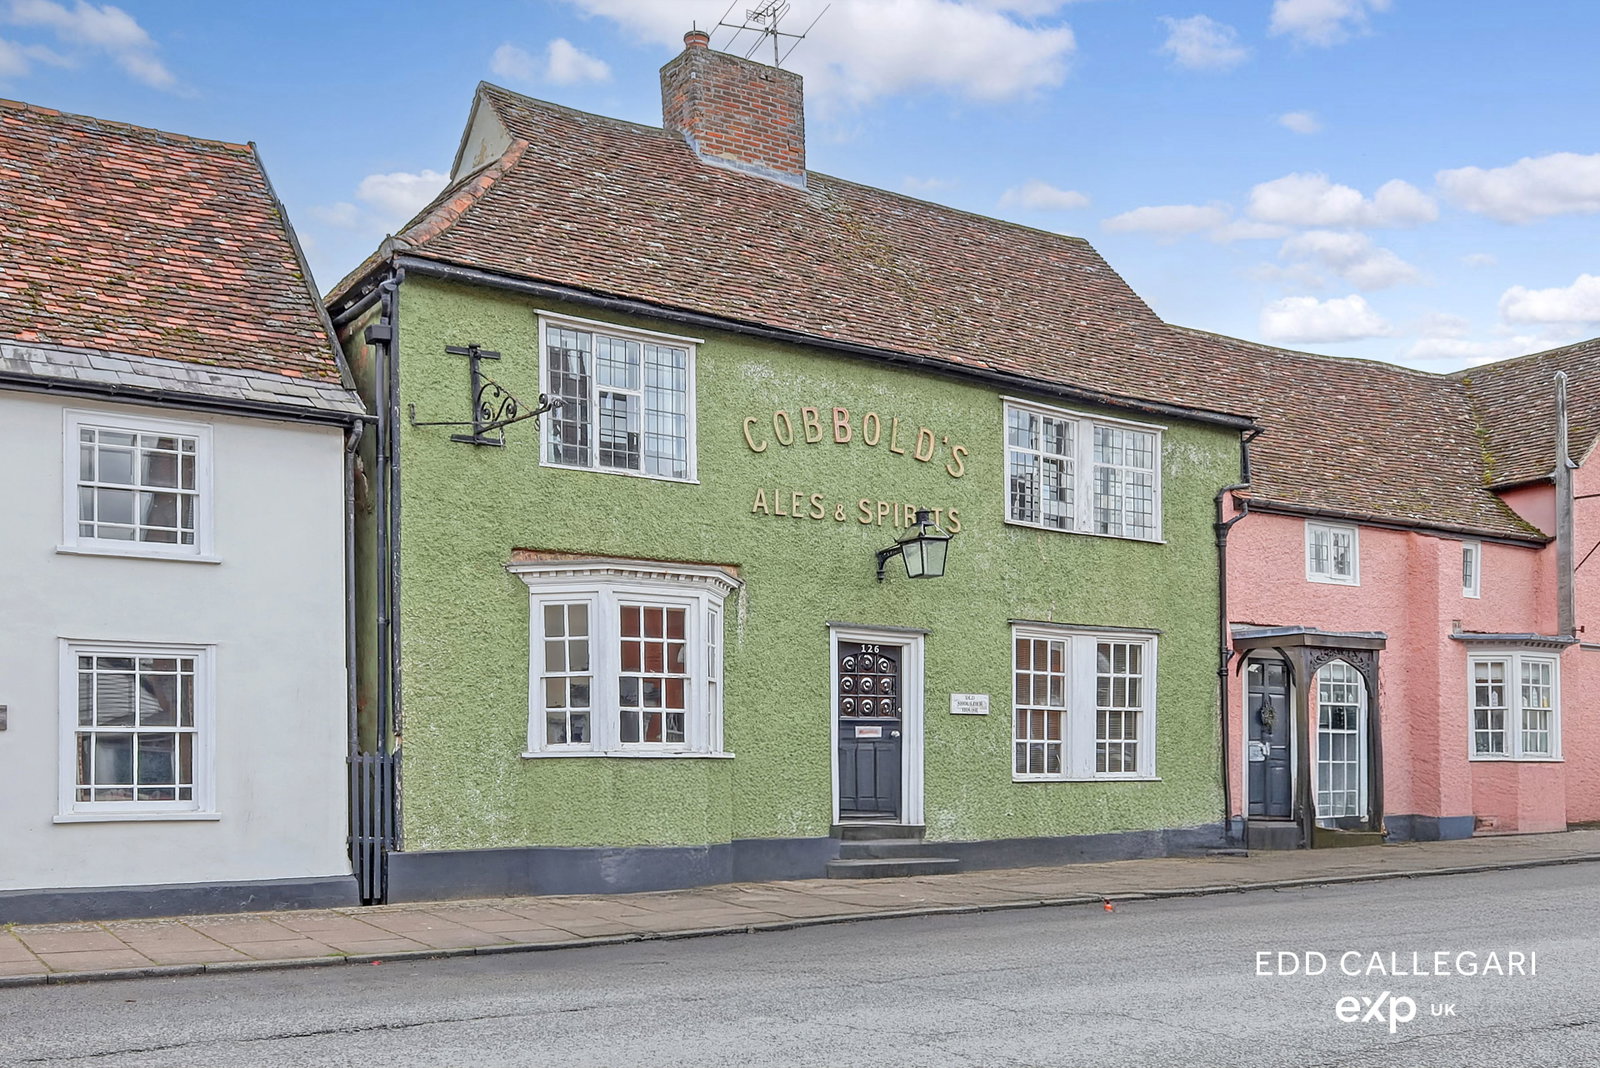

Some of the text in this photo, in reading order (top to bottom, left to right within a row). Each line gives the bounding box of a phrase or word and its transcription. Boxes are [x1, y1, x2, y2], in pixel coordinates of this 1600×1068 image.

[743, 407, 968, 477] COBBOLD'S
[752, 488, 961, 534] ALES & SPIRTS
[861, 644, 880, 653] 126
